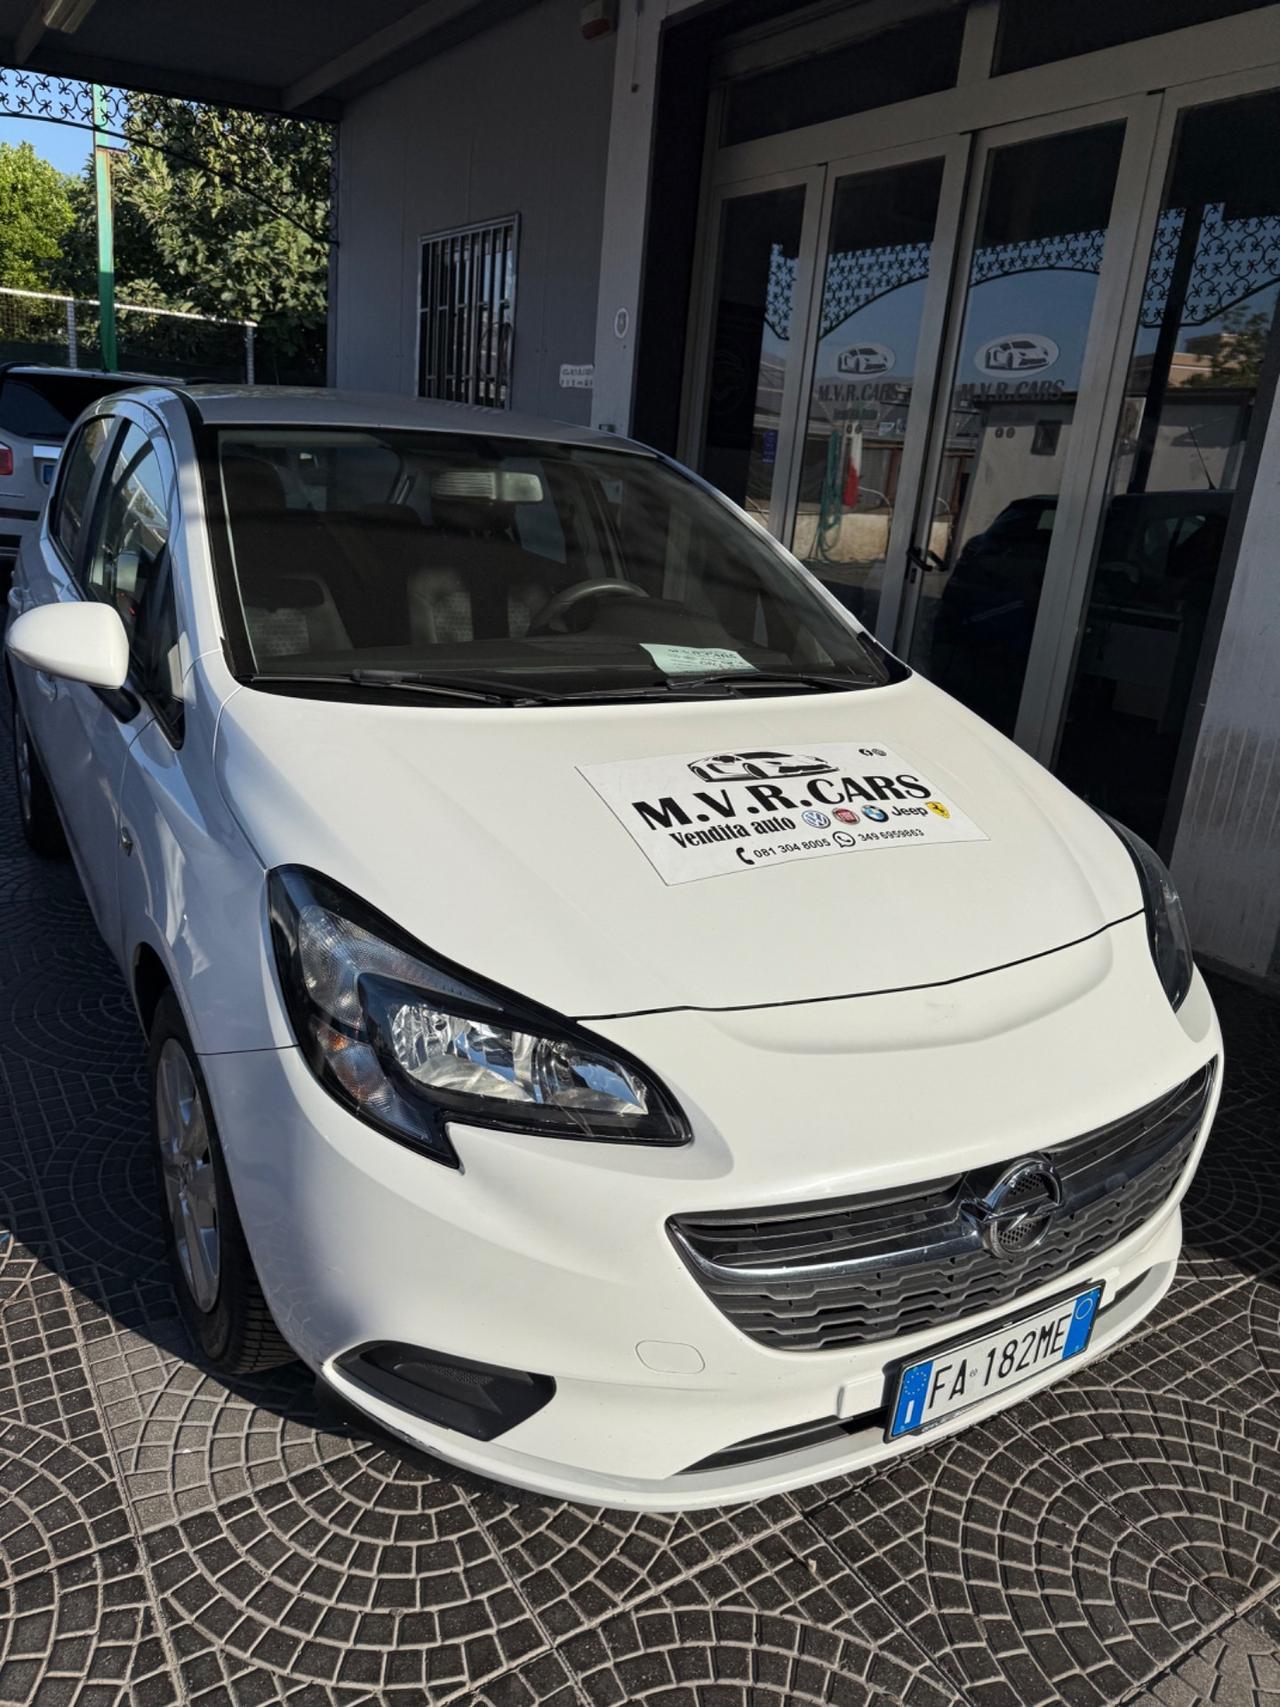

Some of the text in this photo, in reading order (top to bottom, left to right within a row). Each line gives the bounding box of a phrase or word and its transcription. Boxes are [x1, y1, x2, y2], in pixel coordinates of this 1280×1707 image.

[632, 774, 932, 831] M.V.R.CARS
[891, 805, 929, 818] Jeep
[669, 814, 796, 849] Vendita auto
[753, 846, 777, 859] 081
[779, 841, 802, 855] 304
[803, 838, 831, 852] 8005
[857, 832, 880, 842] 349
[928, 1315, 1073, 1409] FA 182ME
